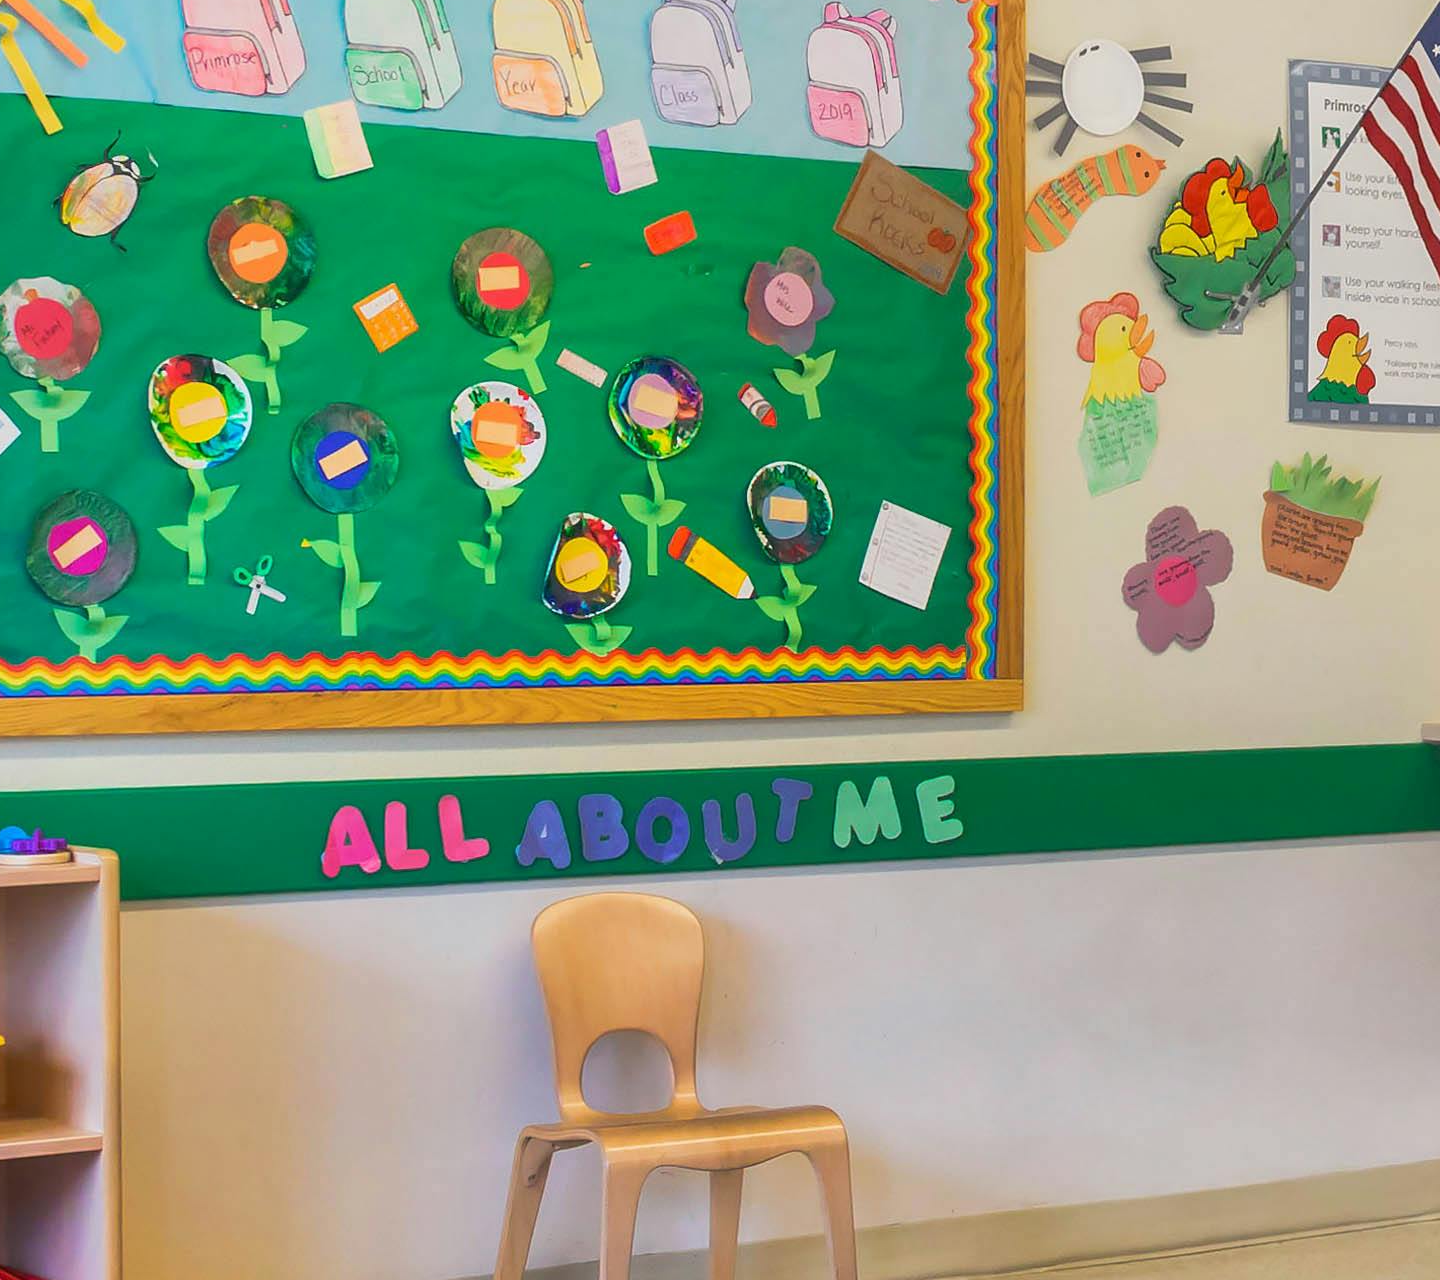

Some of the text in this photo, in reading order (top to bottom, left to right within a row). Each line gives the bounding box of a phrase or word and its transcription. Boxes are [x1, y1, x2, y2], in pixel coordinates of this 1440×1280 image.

[188, 46, 258, 74] Primrose
[352, 64, 406, 87] School
[498, 69, 538, 97] Year
[659, 82, 700, 107] Class
[817, 102, 854, 121] 2019
[1345, 172, 1362, 183] Use
[1364, 174, 1385, 185] your
[1345, 185, 1380, 200] looking
[1345, 224, 1371, 237] Keep
[1372, 226, 1393, 238] your
[1345, 276, 1361, 288] Use
[1364, 279, 1385, 290] your
[1387, 279, 1421, 293] walking
[1345, 291, 1372, 303] inside
[1374, 294, 1400, 305] voice
[1402, 295, 1410, 305] in
[320, 774, 966, 879] ALL ABOUT ME
